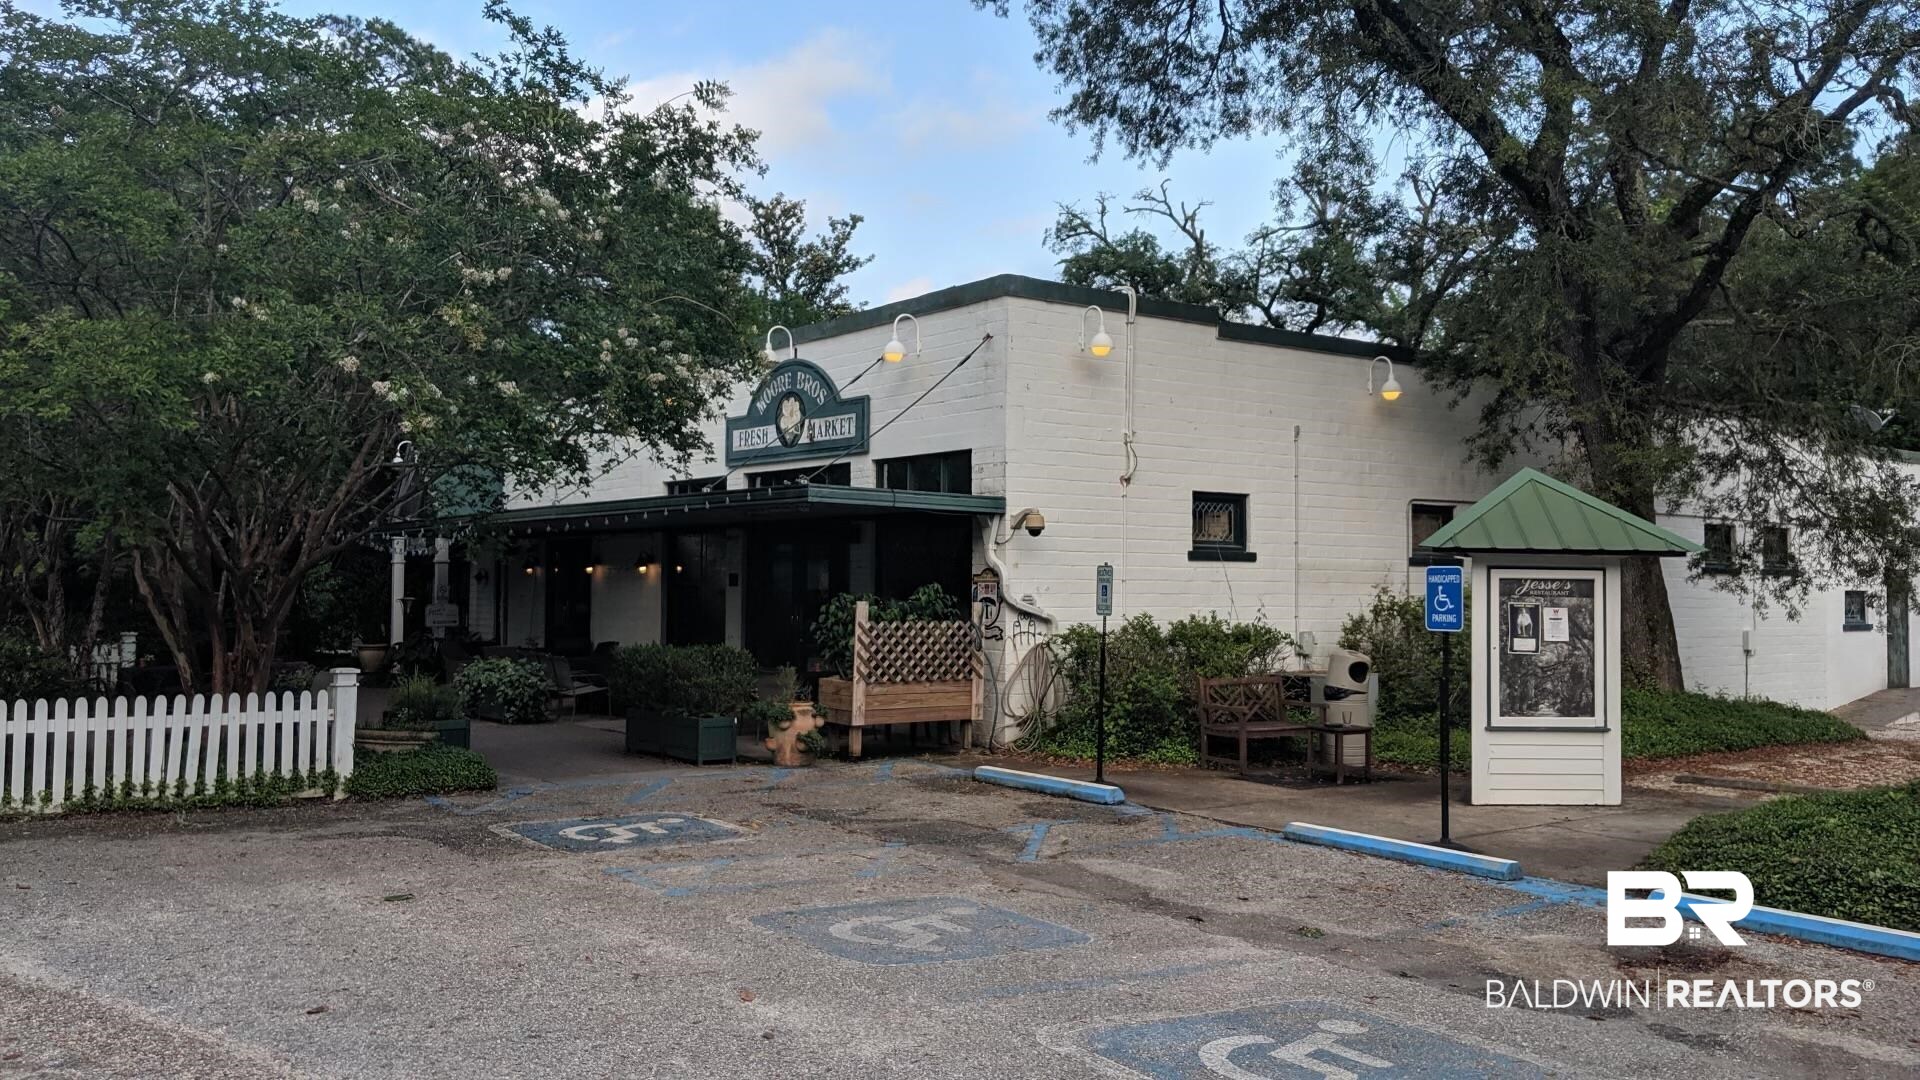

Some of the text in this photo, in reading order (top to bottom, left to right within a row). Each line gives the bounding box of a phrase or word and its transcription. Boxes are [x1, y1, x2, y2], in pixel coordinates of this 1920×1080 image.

[756, 371, 828, 416] MOORE BROS
[738, 416, 854, 448] FRESH MARKET
[1428, 574, 1460, 584] HANDICAPPED
[1515, 579, 1572, 595] Jesse's
[1432, 614, 1457, 623] PARKING
